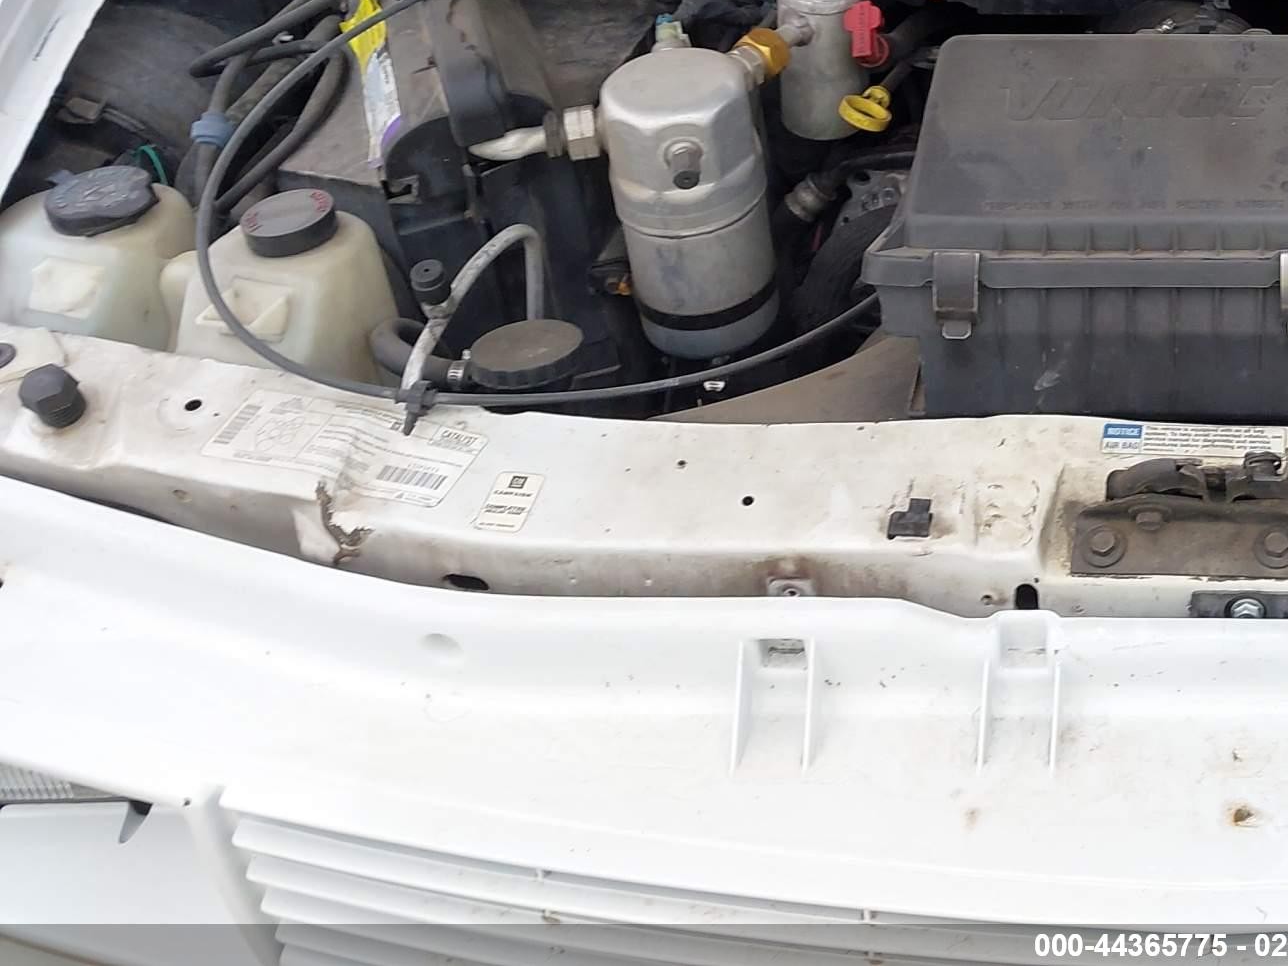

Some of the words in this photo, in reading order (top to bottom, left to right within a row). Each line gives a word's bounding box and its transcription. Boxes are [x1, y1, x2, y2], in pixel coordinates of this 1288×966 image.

[1107, 426, 1141, 436] NOTICE
[441, 429, 479, 445] CATALYST
[1104, 441, 1120, 450] AIR
[1121, 441, 1139, 450] BAG
